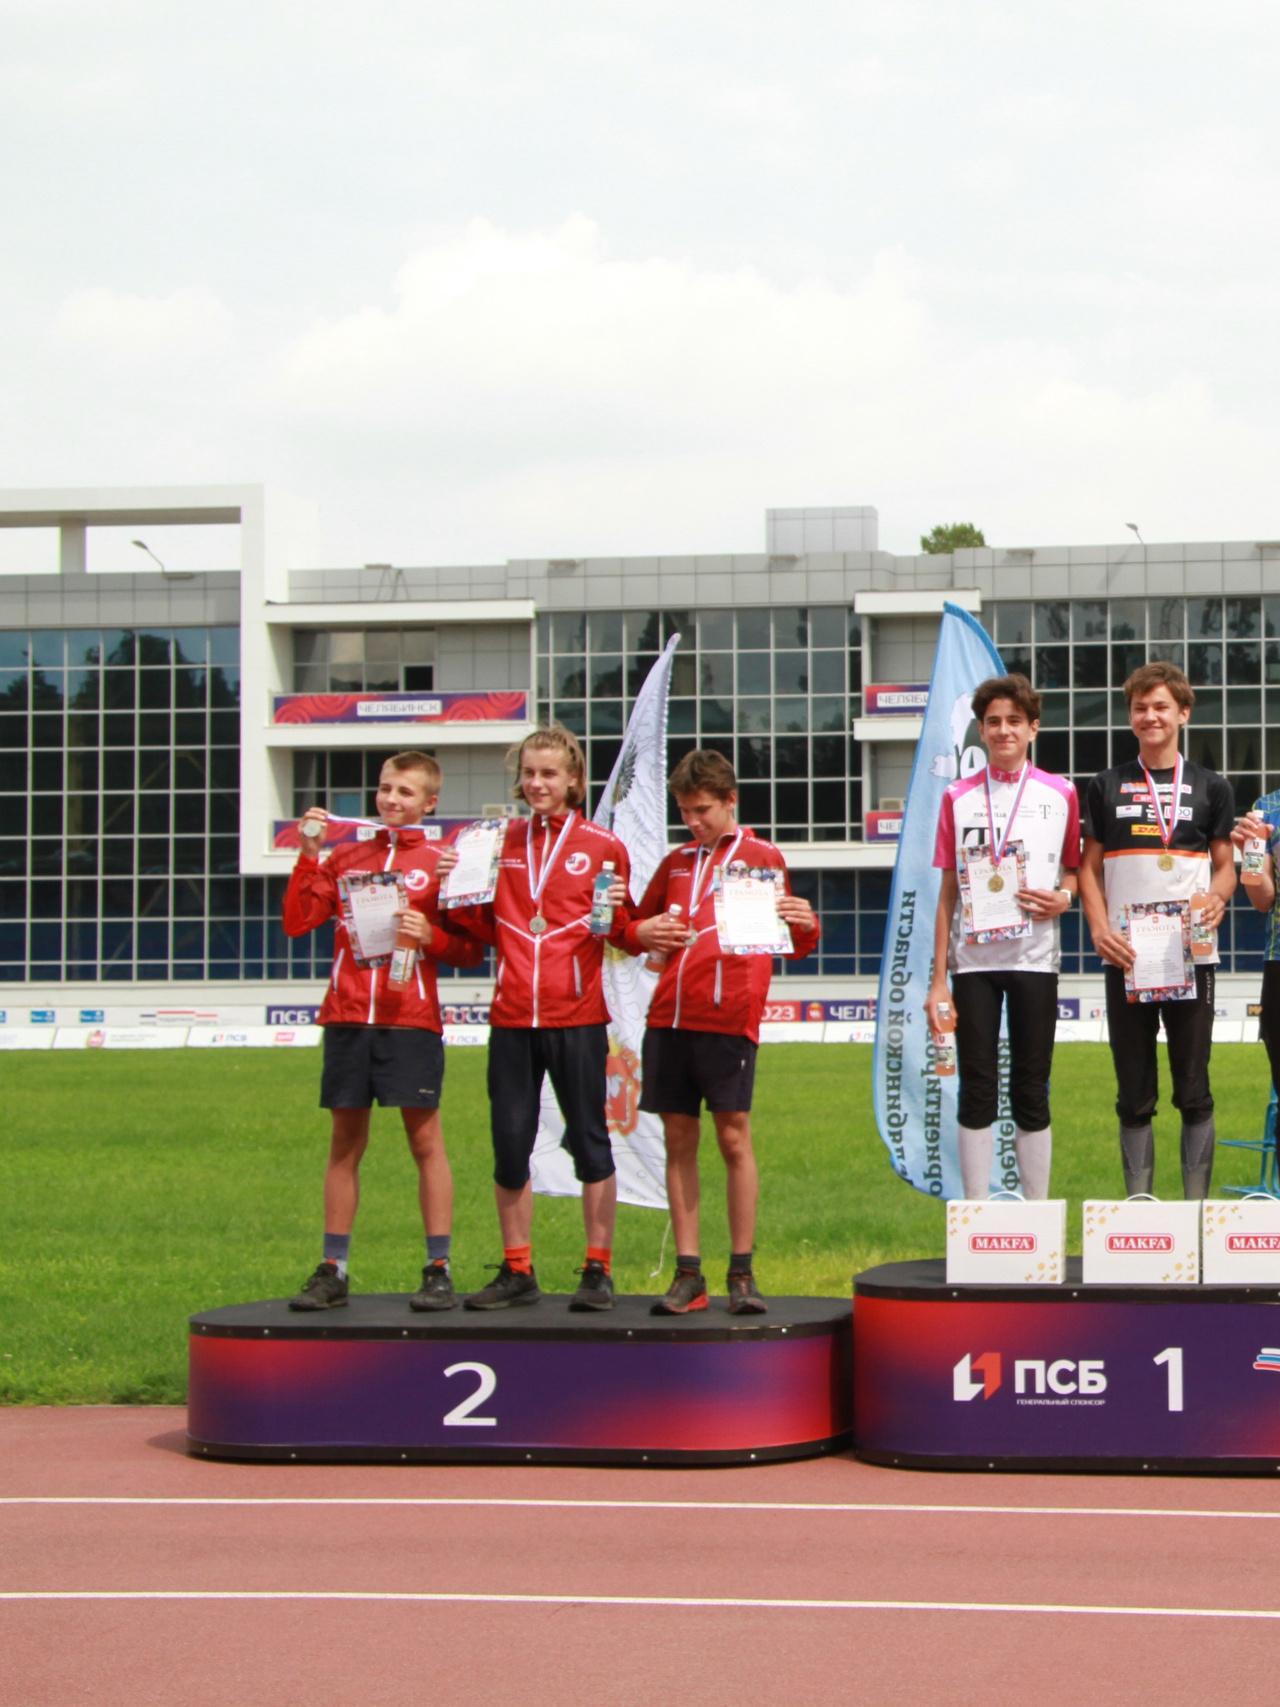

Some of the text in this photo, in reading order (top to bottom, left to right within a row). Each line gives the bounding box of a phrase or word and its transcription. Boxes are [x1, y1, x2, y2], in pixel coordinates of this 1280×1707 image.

[879, 694, 928, 704] ЧЕЛЯБ
[359, 703, 439, 713] ЧЕЛЯБИНСК
[1136, 924, 1176, 933] ГРАМОТА
[270, 1010, 311, 1023] ПСБ
[975, 1238, 1031, 1249] MAKFA
[1112, 1238, 1169, 1249] MAKFA
[1013, 1360, 1108, 1395] ПСБ
[1152, 1347, 1184, 1412] 1
[443, 1361, 497, 1426] 2
